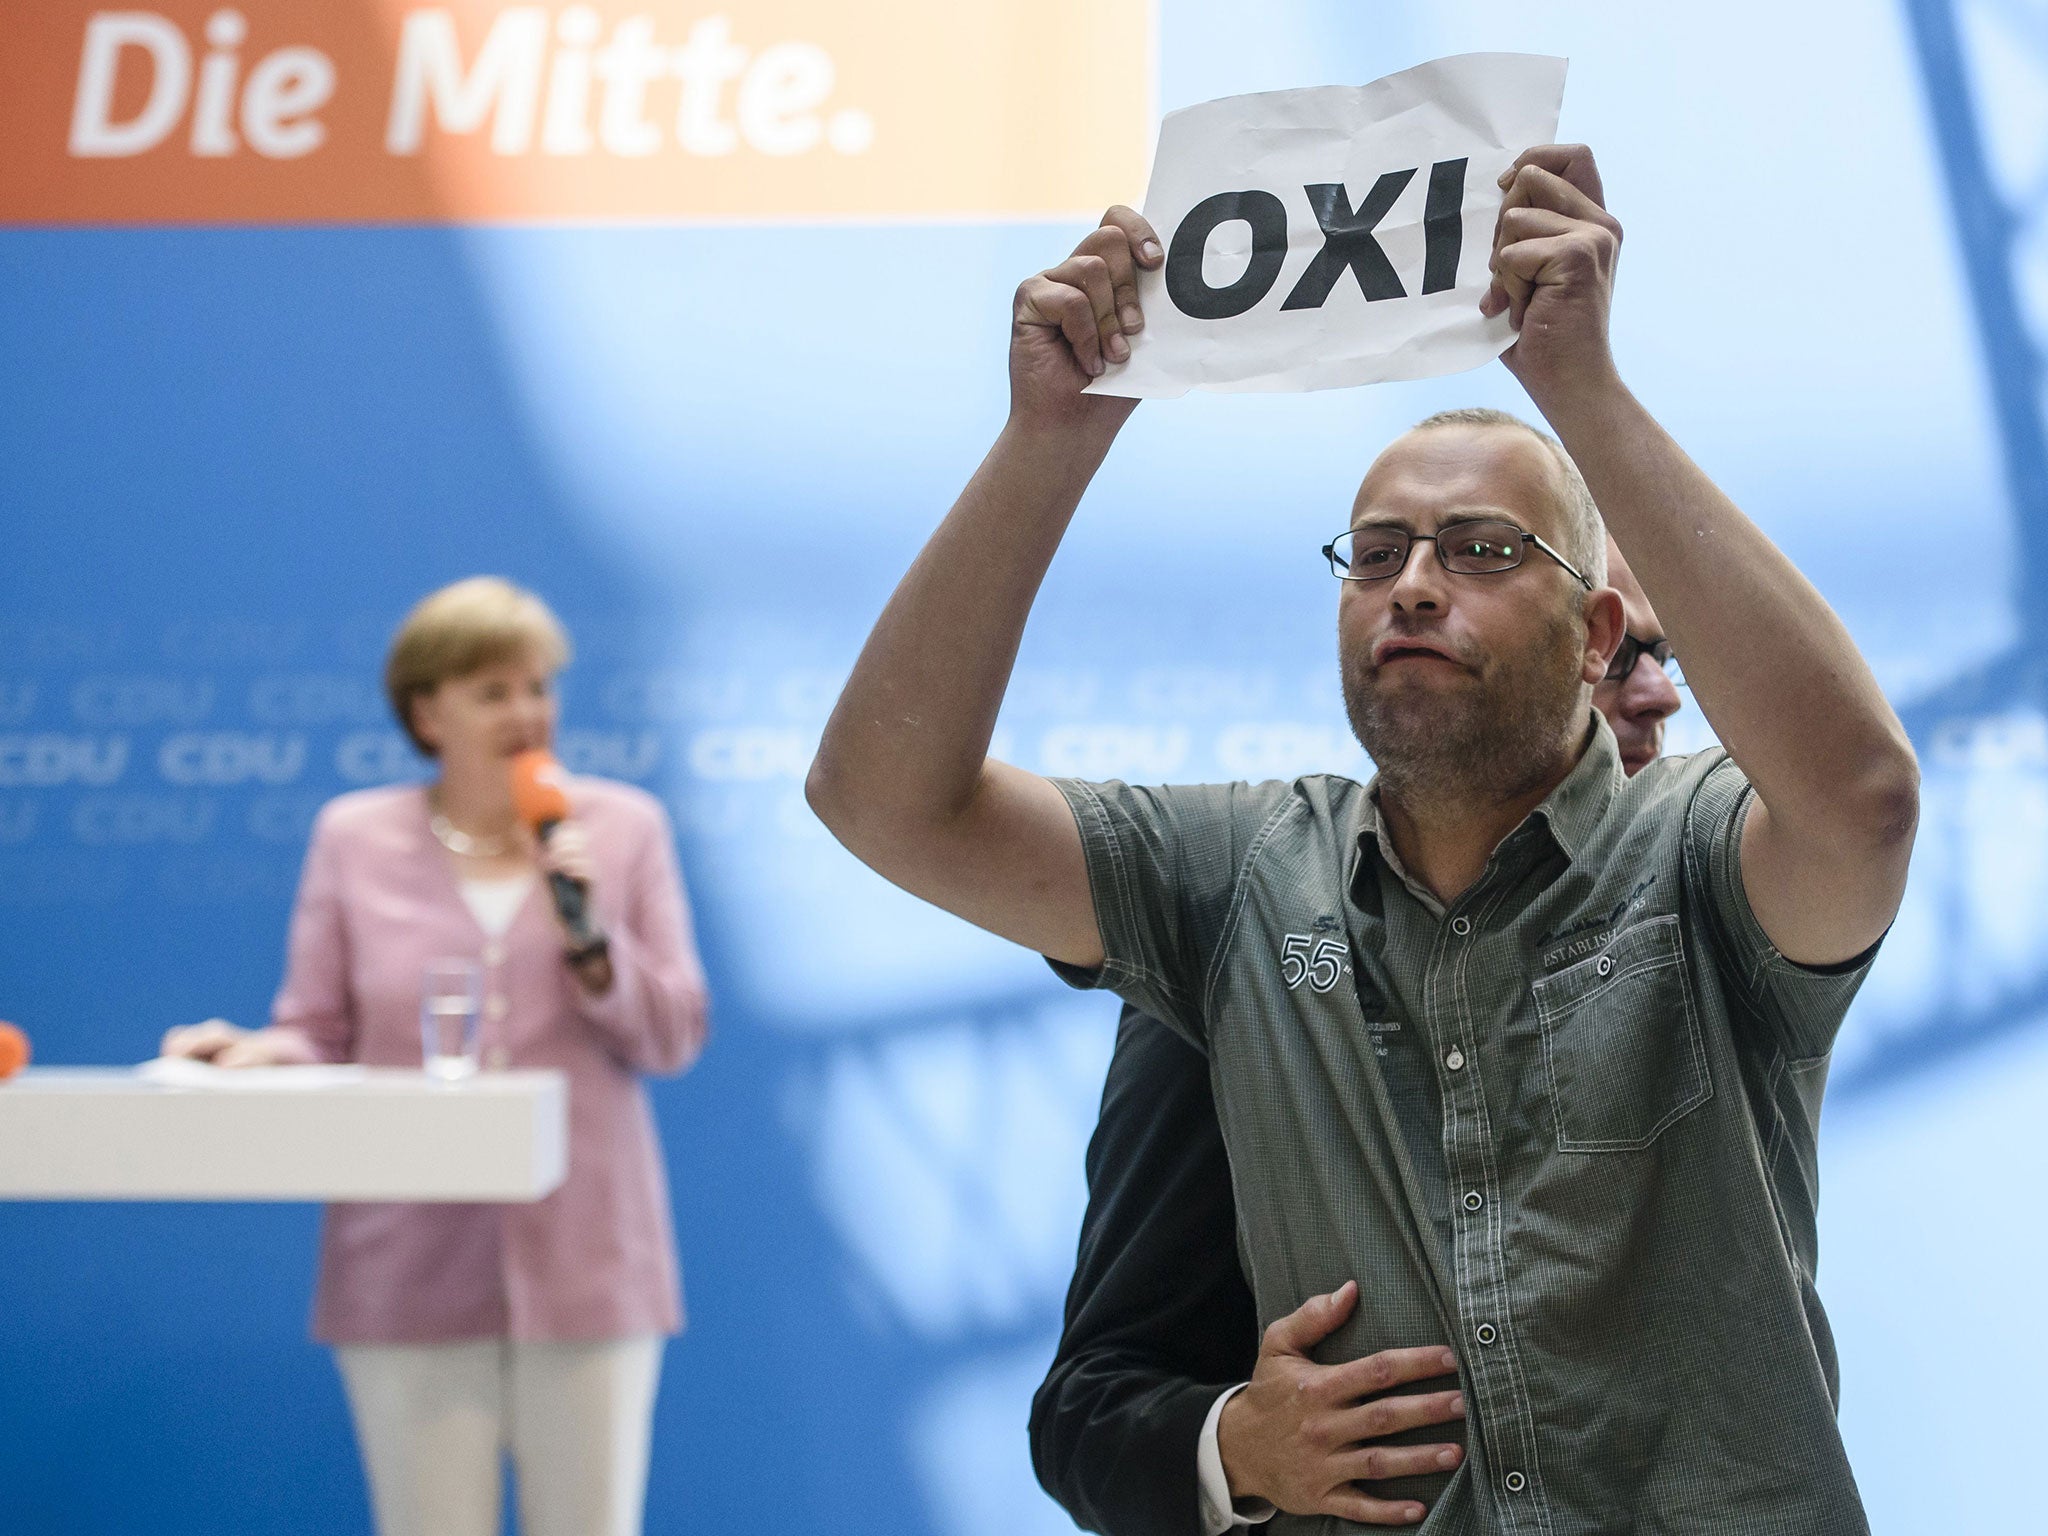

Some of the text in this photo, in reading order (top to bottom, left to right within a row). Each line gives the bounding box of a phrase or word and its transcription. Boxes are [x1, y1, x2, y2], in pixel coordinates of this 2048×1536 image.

[67, 4, 876, 158] Die Mitte.
[1165, 157, 1469, 320] OXI
[157, 730, 306, 786] CDU
[334, 730, 438, 784] CD
[1042, 723, 1190, 776] CDU
[1281, 933, 1349, 993] 55
